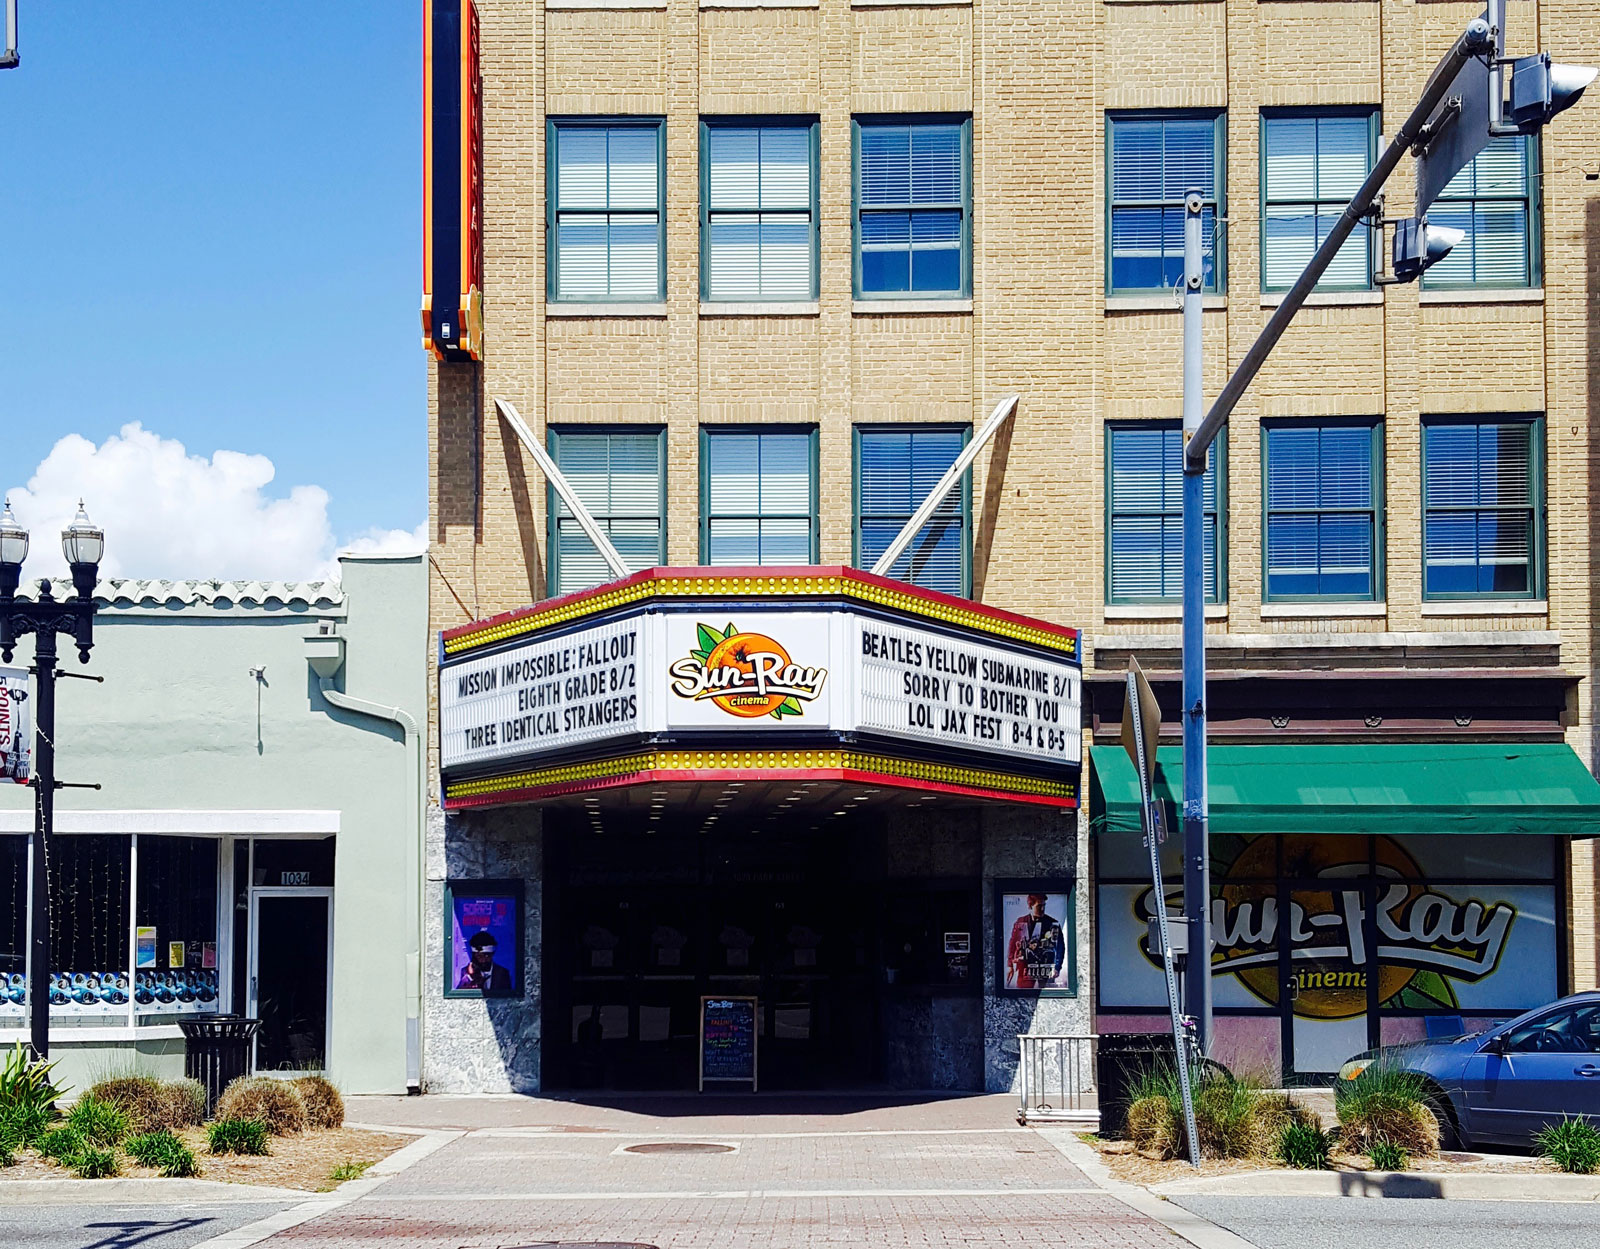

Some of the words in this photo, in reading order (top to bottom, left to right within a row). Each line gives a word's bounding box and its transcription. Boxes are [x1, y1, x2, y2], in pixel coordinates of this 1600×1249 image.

[458, 668, 497, 698] MISSION
[579, 632, 637, 668] FALLOUT
[519, 681, 560, 711] EIGHTH
[565, 671, 605, 700] GRADE
[610, 664, 636, 691] 8/2
[669, 651, 828, 701] Sun-Ray
[862, 631, 922, 667] BEATLES
[926, 645, 978, 679] YELLOW
[981, 659, 1048, 694] SUBMARINE
[1054, 676, 1072, 699] 8/1
[0, 686, 10, 746] POINTS
[730, 696, 769, 706] cinema
[903, 671, 950, 701] SORRY
[958, 682, 974, 706] TO
[980, 686, 1028, 718] BOTHER
[1035, 698, 1059, 723] YOU
[465, 724, 497, 750] THREE
[502, 711, 559, 743] IDENTICAL
[564, 695, 637, 731] STRANGERS
[908, 702, 934, 729] LOL
[941, 709, 967, 735] JAX
[973, 714, 1001, 741] FEST
[1012, 722, 1033, 746] 8-4
[1037, 726, 1044, 748] &
[1048, 728, 1065, 751] 8-5
[283, 872, 309, 885] 1034
[1023, 967, 1055, 978] FALLOU
[1291, 969, 1367, 989] inem
